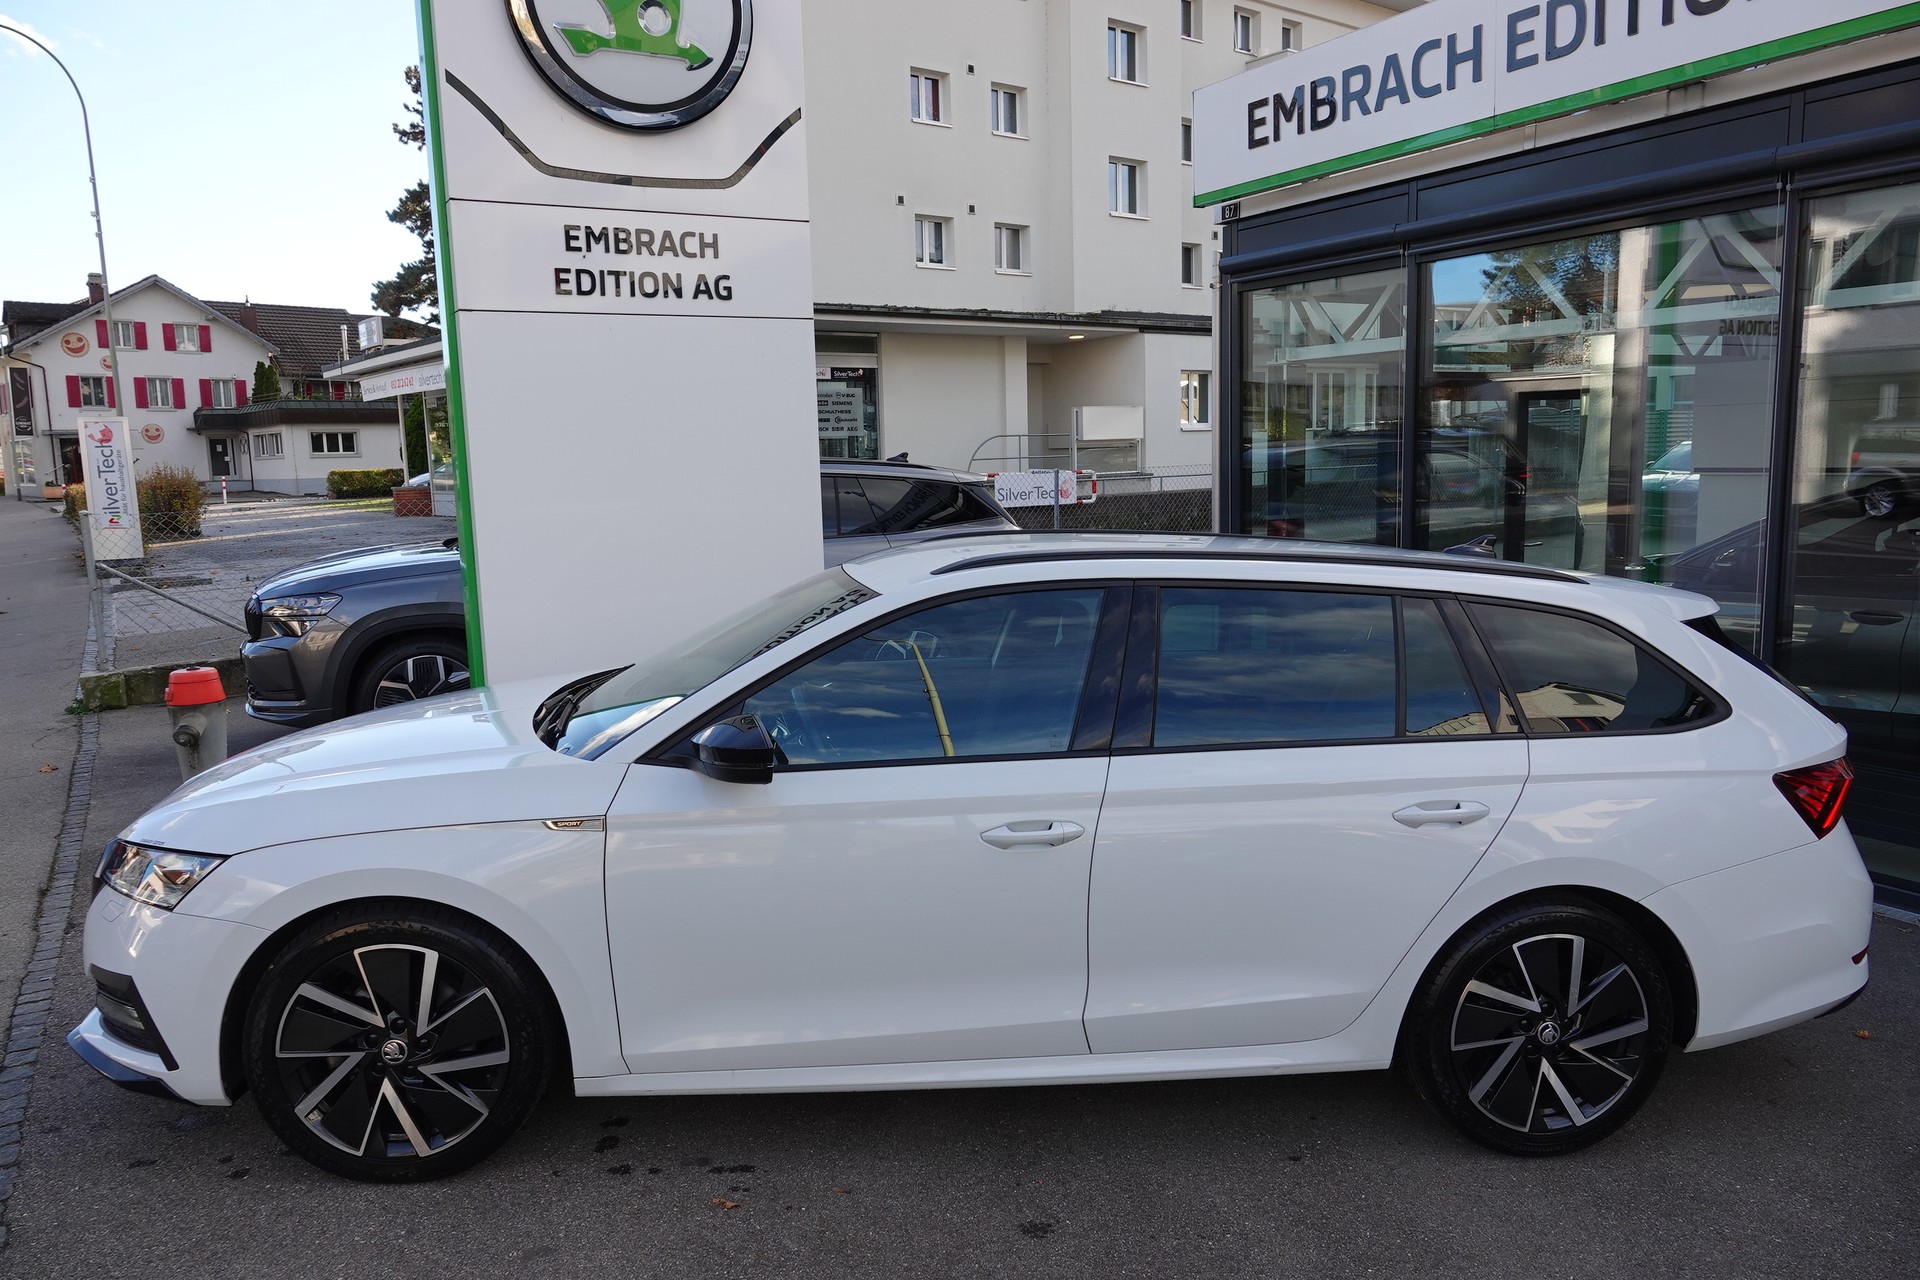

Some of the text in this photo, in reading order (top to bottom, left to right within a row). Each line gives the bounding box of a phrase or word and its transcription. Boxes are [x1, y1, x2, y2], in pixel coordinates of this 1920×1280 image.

[1248, 24, 1484, 150] EMBRACH
[1225, 206, 1235, 218] 87
[564, 224, 719, 259] EMBRACH
[554, 267, 733, 300] EDITION AG
